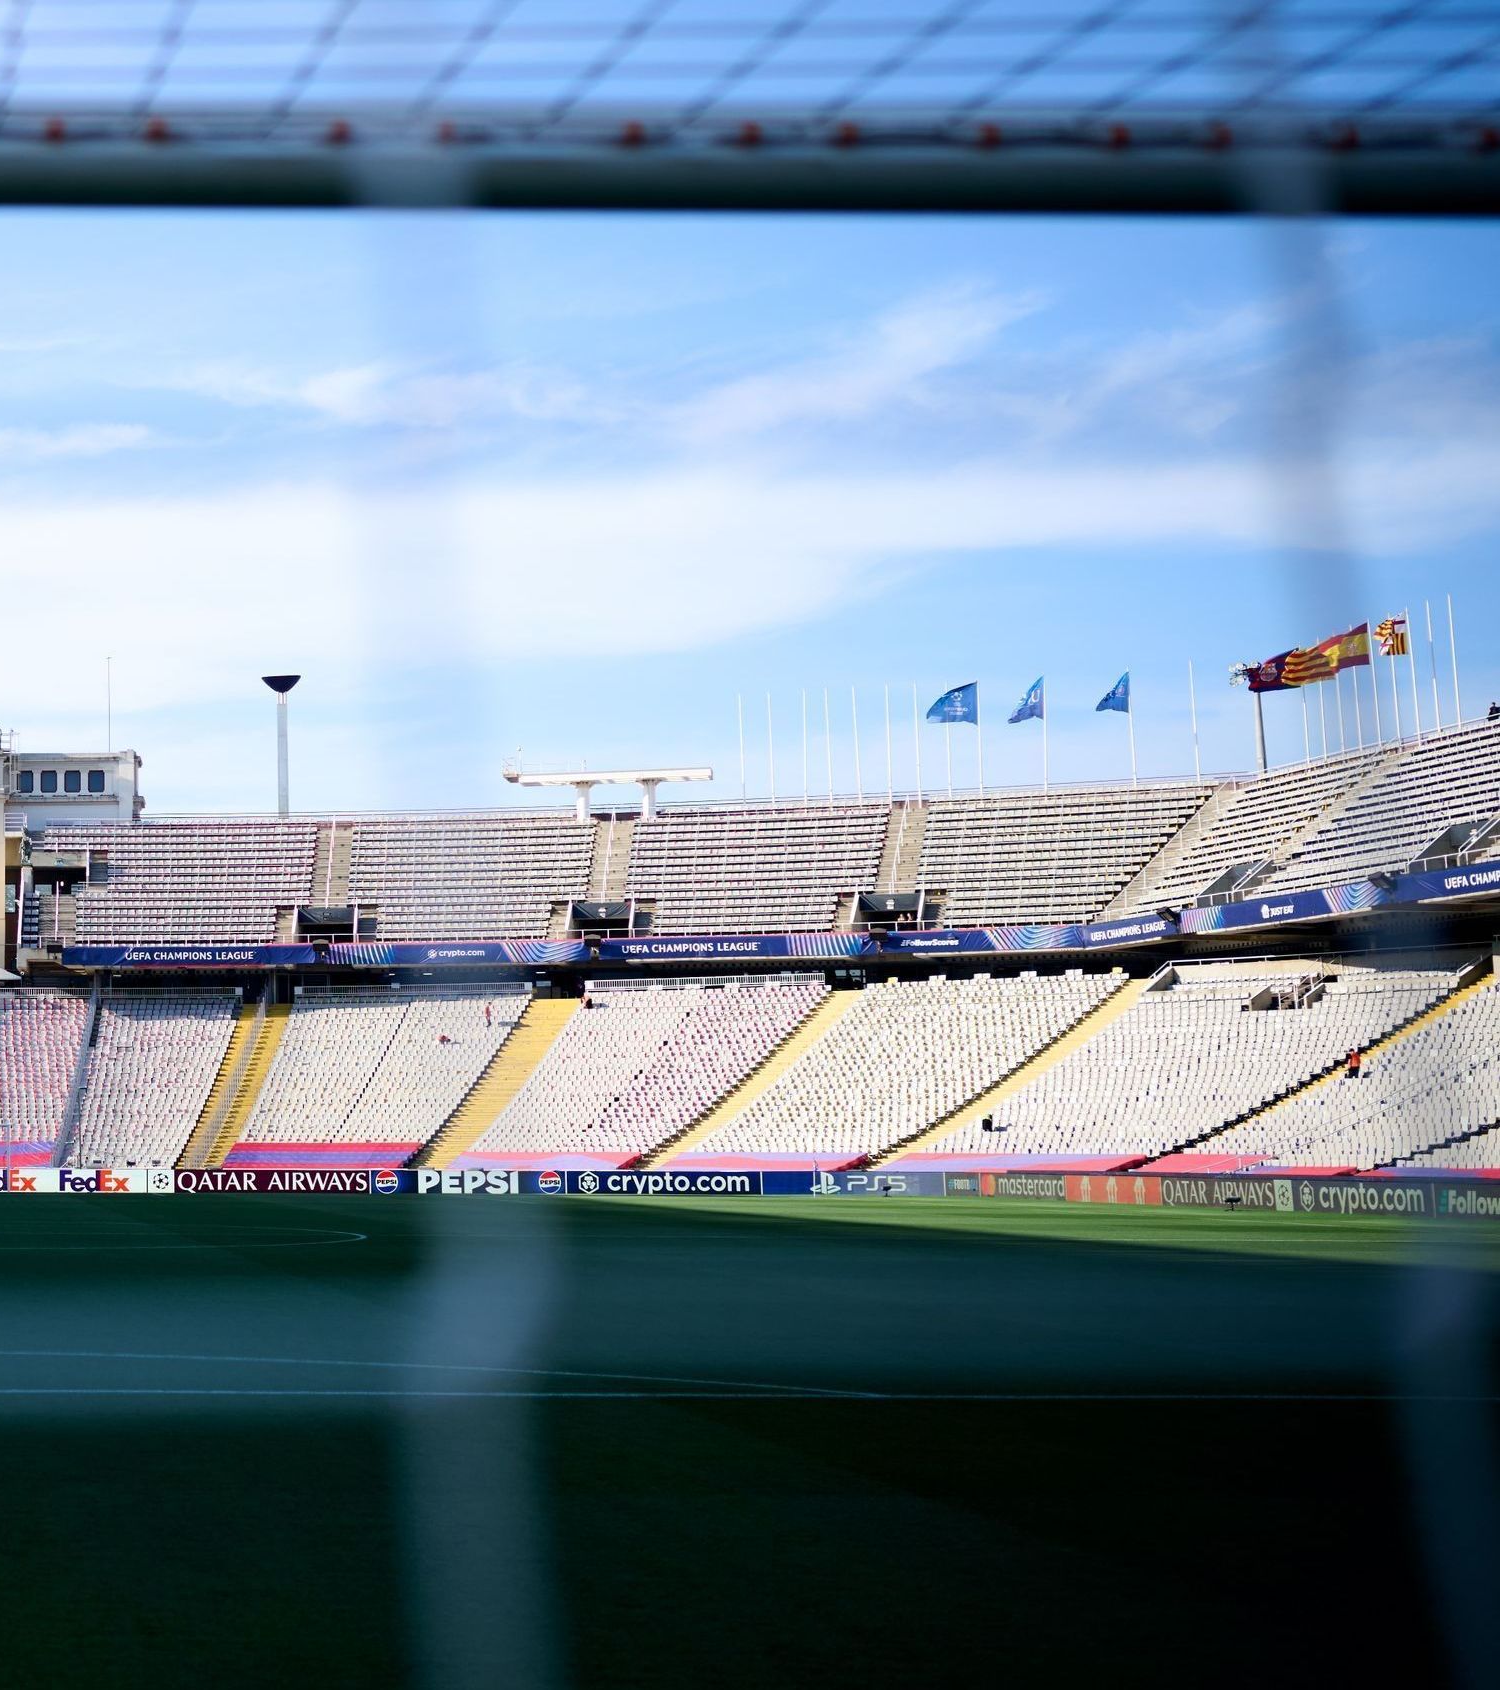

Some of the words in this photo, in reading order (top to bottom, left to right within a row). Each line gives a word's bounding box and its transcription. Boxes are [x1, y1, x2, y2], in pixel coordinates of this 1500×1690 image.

[1444, 875, 1469, 889] UEFA
[1090, 930, 1107, 941] UEFA
[1107, 925, 1141, 939] CHAMPIONS
[1142, 920, 1167, 933] LEAGUE
[125, 951, 152, 960] UEFA
[153, 951, 212, 960] CHAMPIONS
[215, 951, 253, 960] LEAGUE
[438, 949, 485, 957] crypto.com
[621, 944, 649, 954] UEFA
[651, 942, 714, 953] CHAMPIONS
[717, 942, 758, 952] LEAGUE
[59, 1169, 129, 1192] FedEx
[177, 1171, 257, 1193] QATAR
[267, 1171, 368, 1192] AIRWAYS
[418, 1170, 519, 1194] PEPSI
[607, 1172, 750, 1195] crypto.com
[846, 1175, 907, 1192] PS5
[998, 1176, 1065, 1198] mastercard
[1162, 1179, 1208, 1206] QATAR
[1213, 1181, 1275, 1207] AIRWAYS
[1319, 1182, 1425, 1214] crypto.com
[1448, 1189, 1500, 1215] Follow
